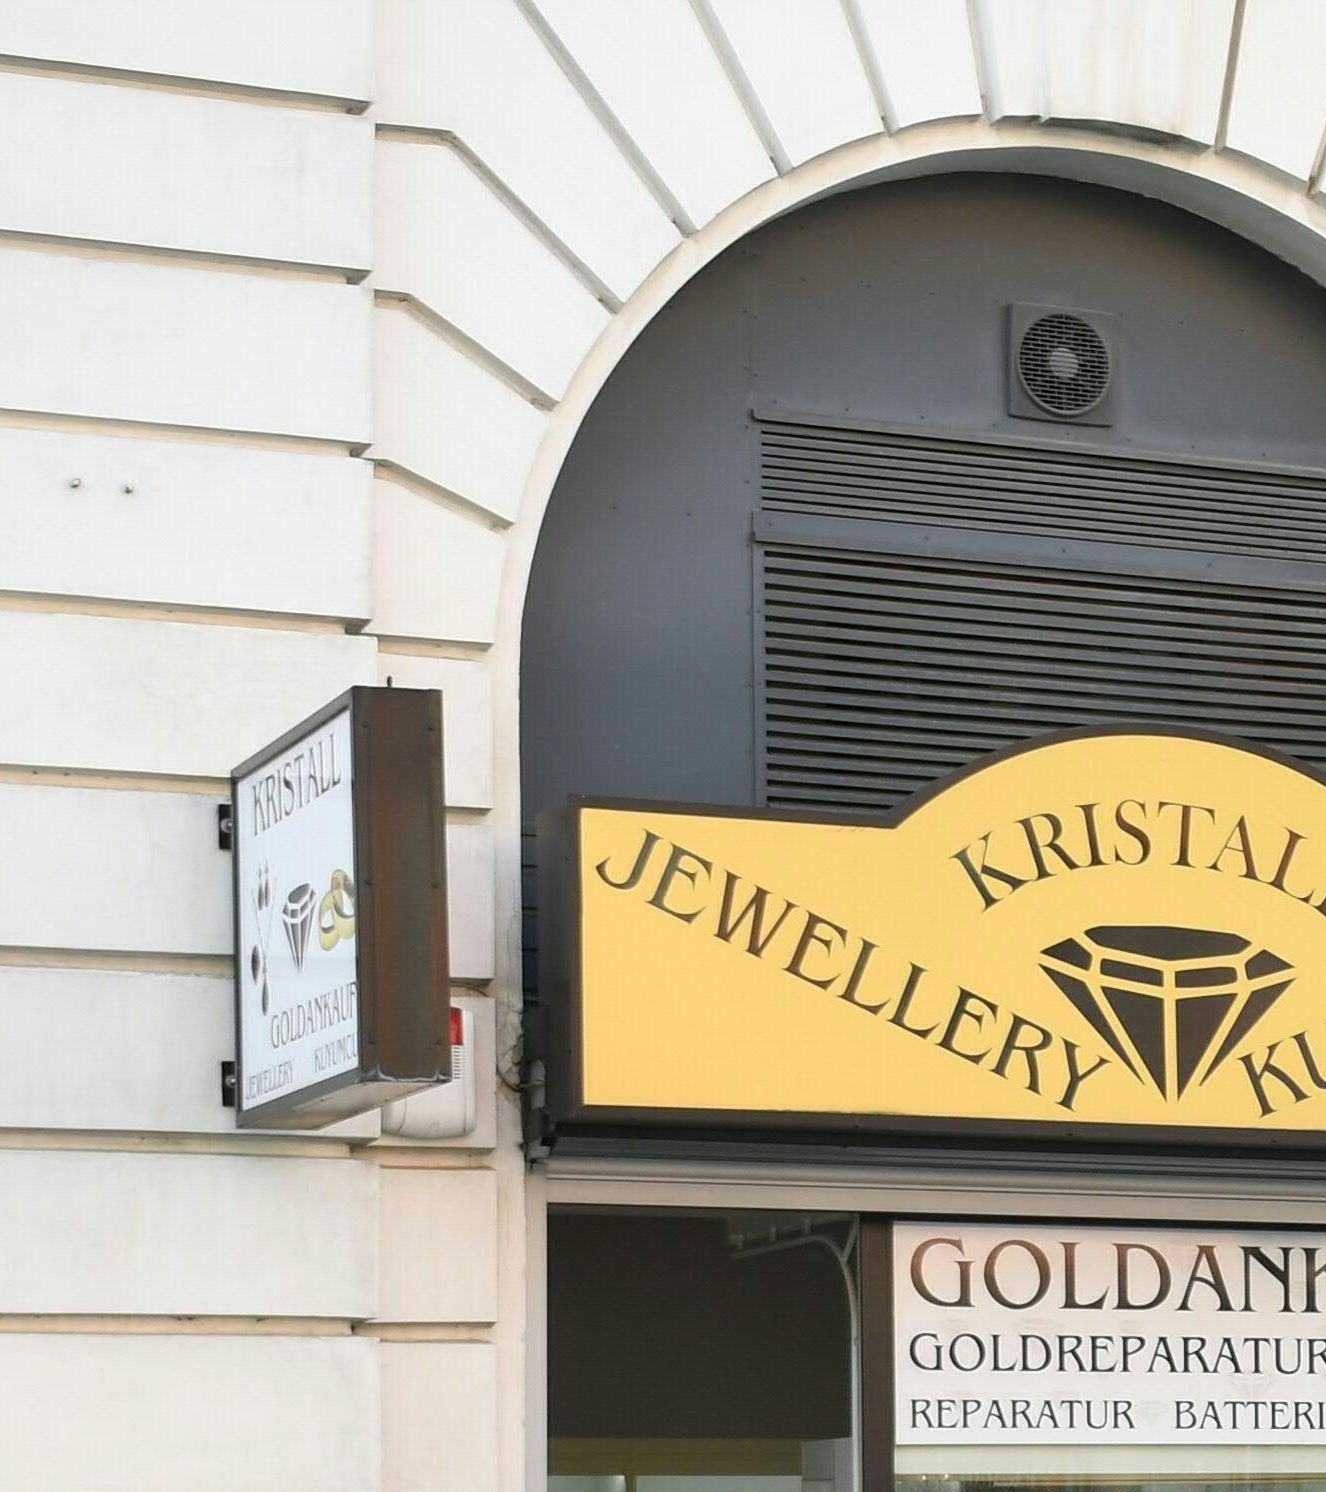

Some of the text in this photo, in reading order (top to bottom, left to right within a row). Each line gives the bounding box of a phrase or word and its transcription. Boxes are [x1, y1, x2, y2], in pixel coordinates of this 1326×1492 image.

[253, 733, 341, 837] KRISTALL
[595, 829, 1113, 1112] JEWELLERY
[271, 980, 358, 1049] GOLDANKAUF
[246, 1058, 293, 1101] JEWELLERY
[909, 1398, 1135, 1431] REPARATUR
